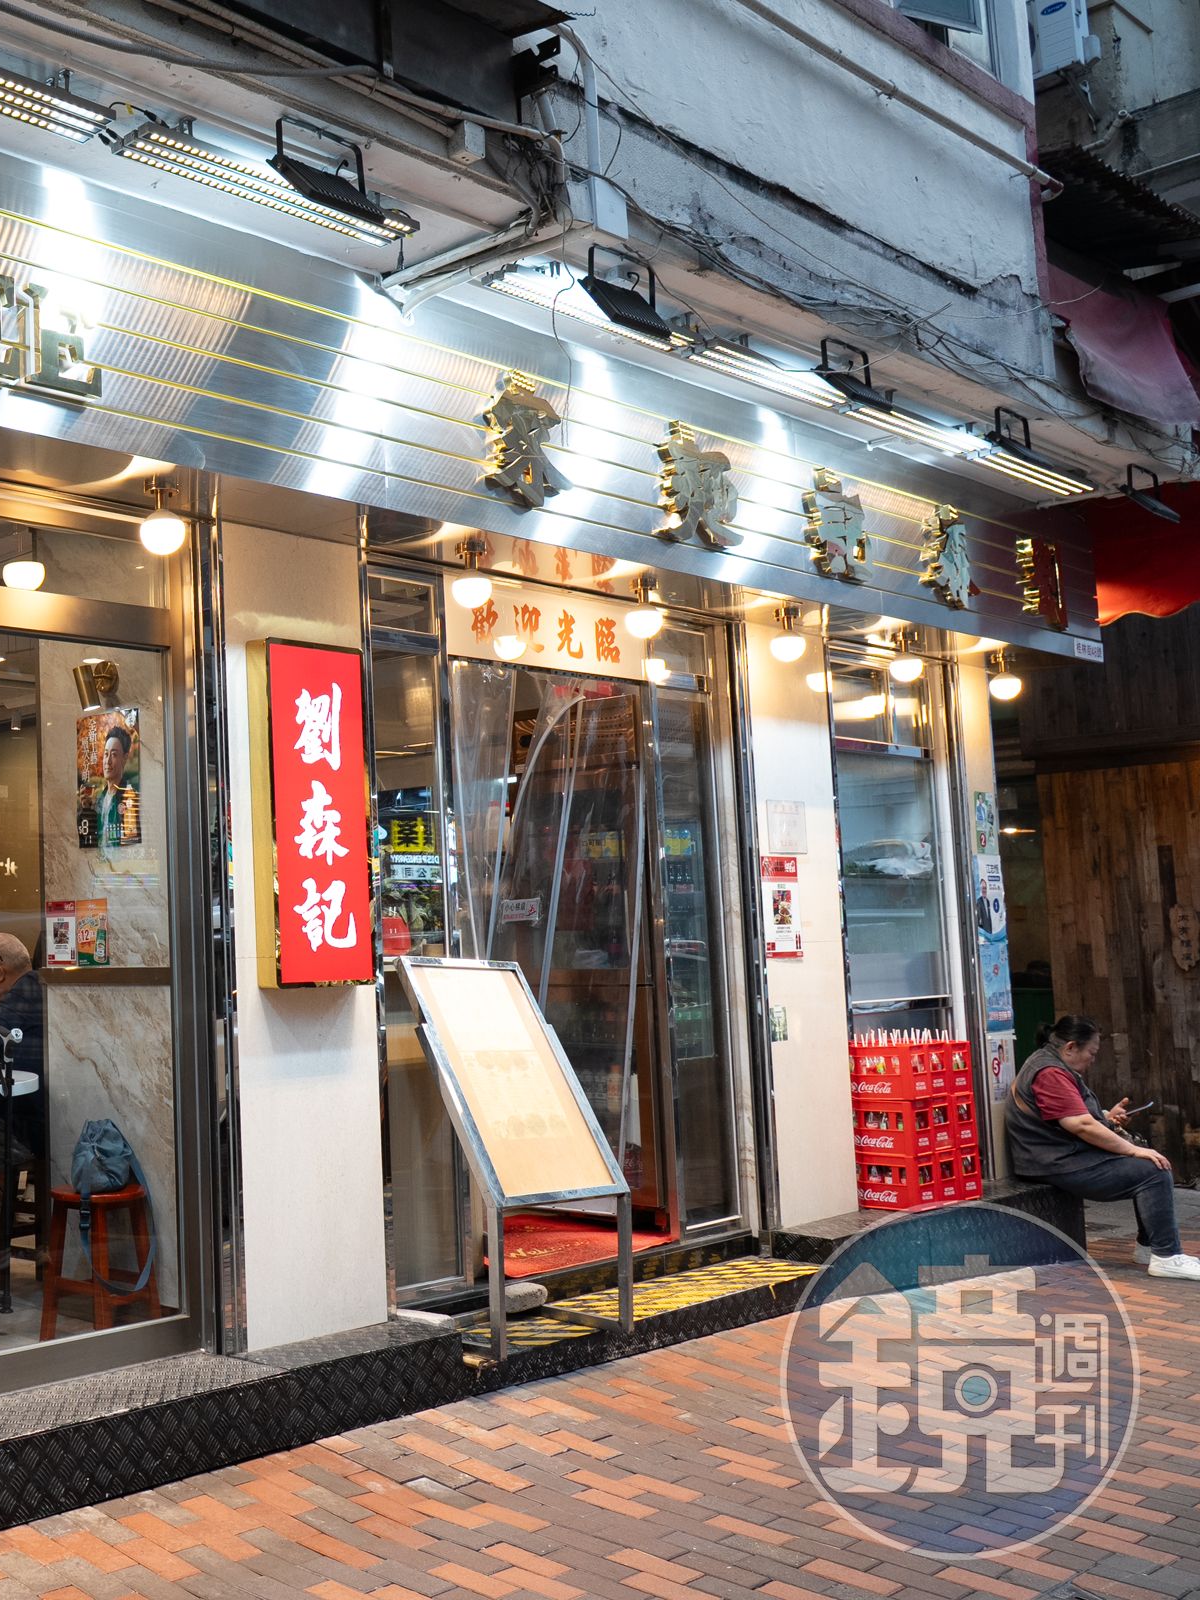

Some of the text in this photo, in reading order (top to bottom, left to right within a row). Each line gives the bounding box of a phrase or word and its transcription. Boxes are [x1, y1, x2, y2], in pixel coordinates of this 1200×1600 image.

[293, 682, 357, 952] 劉森記
[993, 1059, 999, 1075] 5
[858, 1081, 891, 1094] Coca-Cola
[861, 1134, 894, 1149] Coca-Cola
[864, 1188, 897, 1203] Coca-Cola
